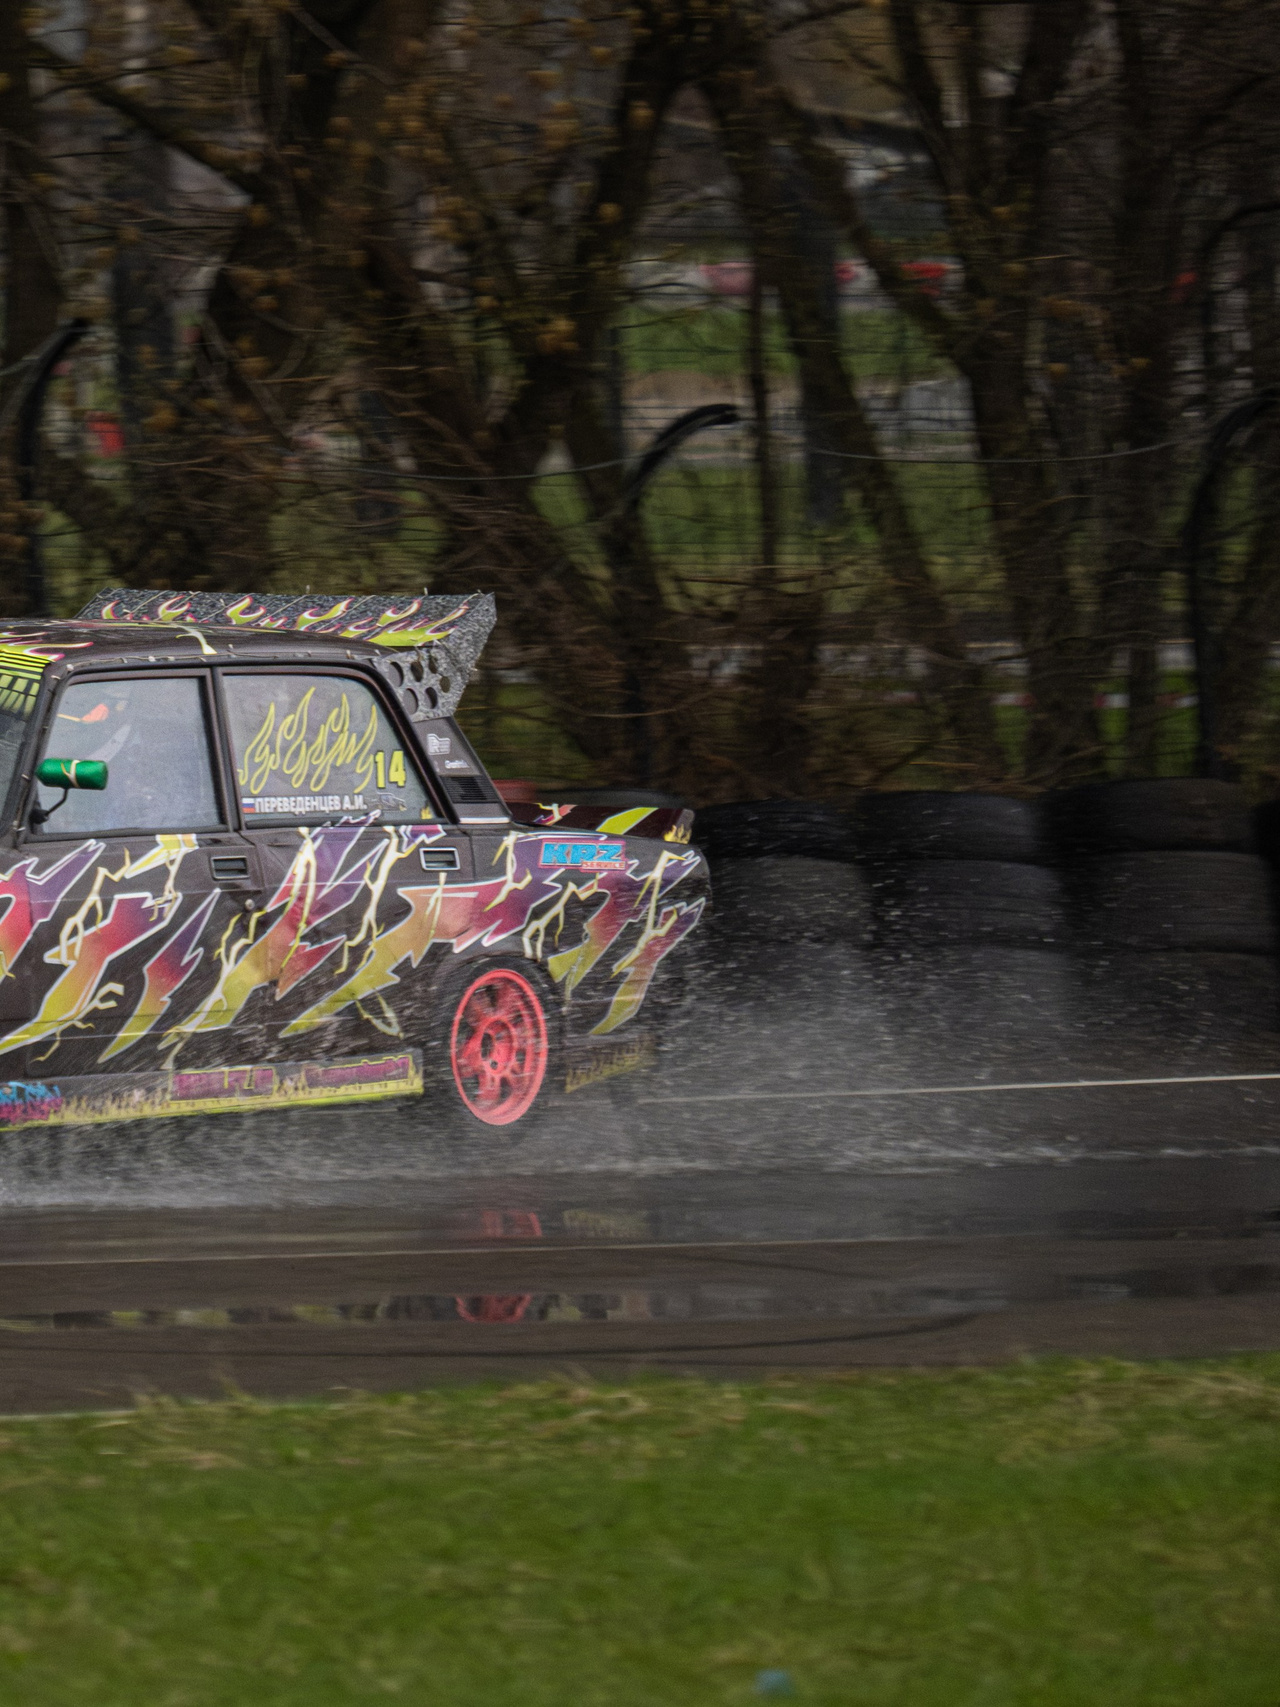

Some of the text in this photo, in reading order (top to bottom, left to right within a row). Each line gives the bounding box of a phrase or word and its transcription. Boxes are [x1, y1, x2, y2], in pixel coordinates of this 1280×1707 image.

[375, 750, 407, 789] 14
[254, 795, 341, 815] ПЕРЕВЕДЕНЦЕВ
[541, 843, 623, 865] KRZ
